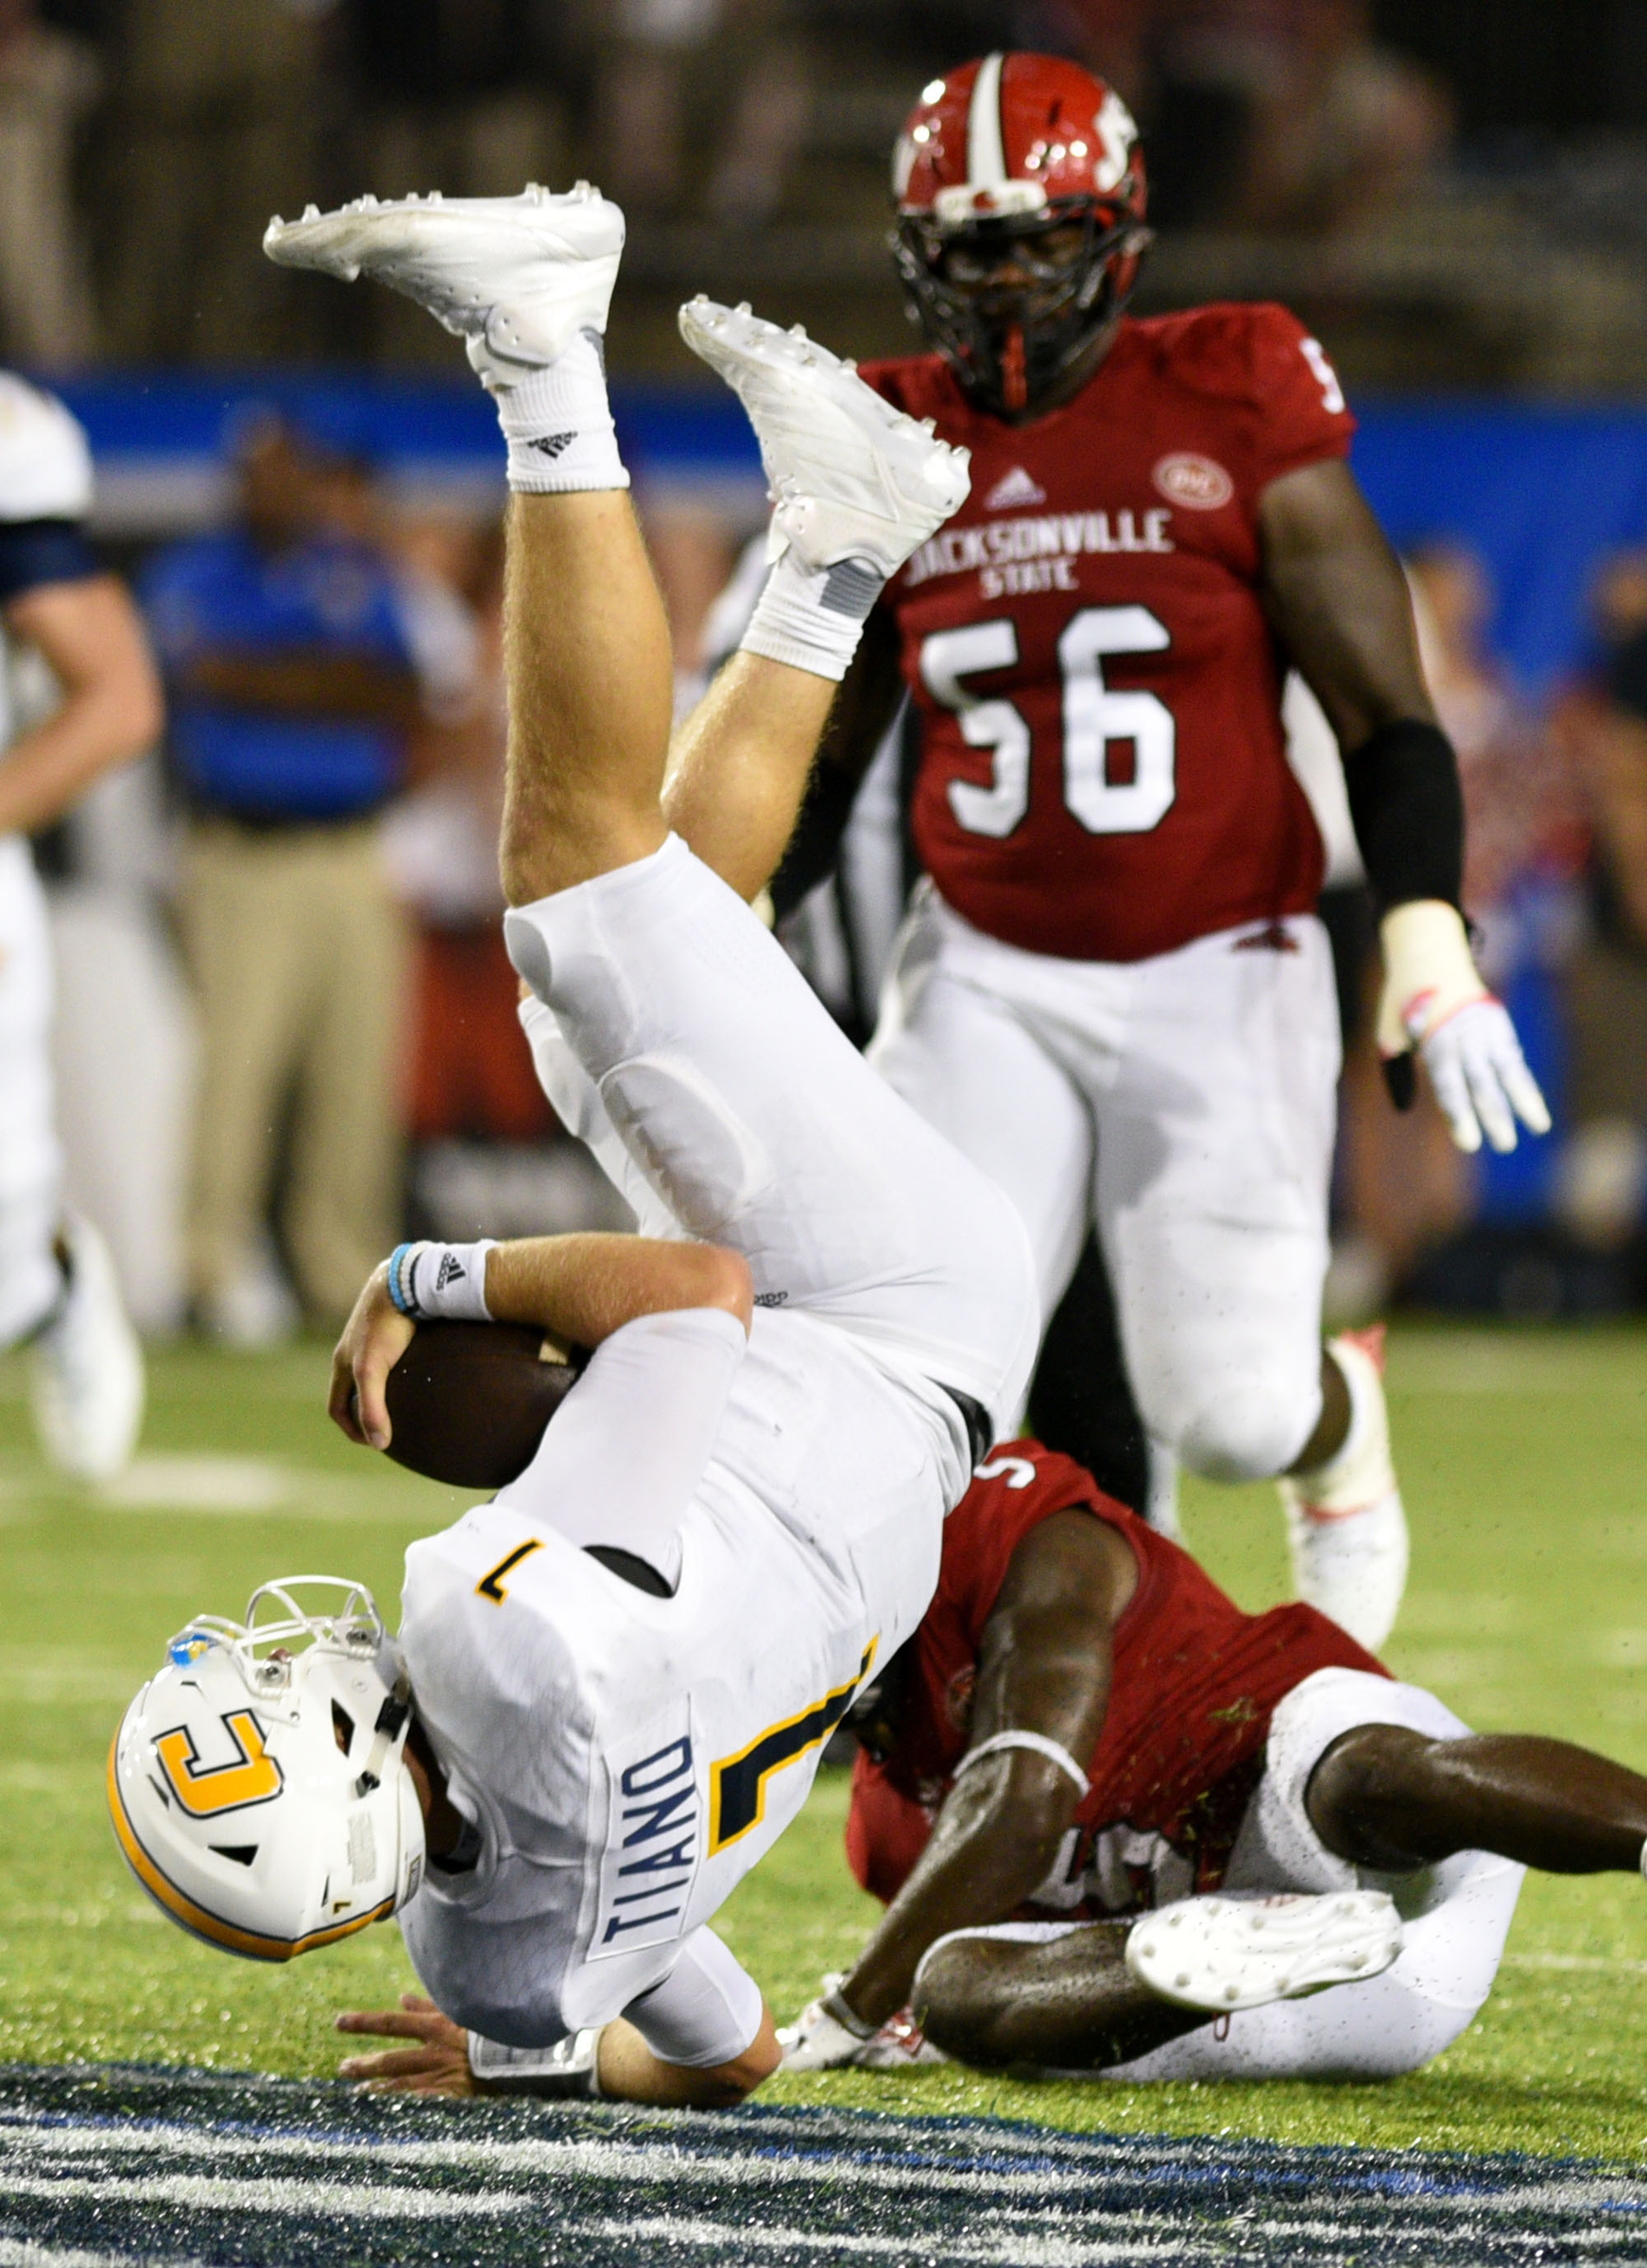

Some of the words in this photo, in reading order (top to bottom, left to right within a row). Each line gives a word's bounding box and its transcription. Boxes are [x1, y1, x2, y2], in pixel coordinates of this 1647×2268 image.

[979, 555, 1079, 601] STATE
[920, 605, 1176, 837] 56
[436, 1252, 452, 1292] adidas
[474, 1536, 547, 1607] 7
[150, 1708, 285, 1820] C
[702, 1632, 880, 1860] 7
[602, 1735, 696, 1944] TIANO
